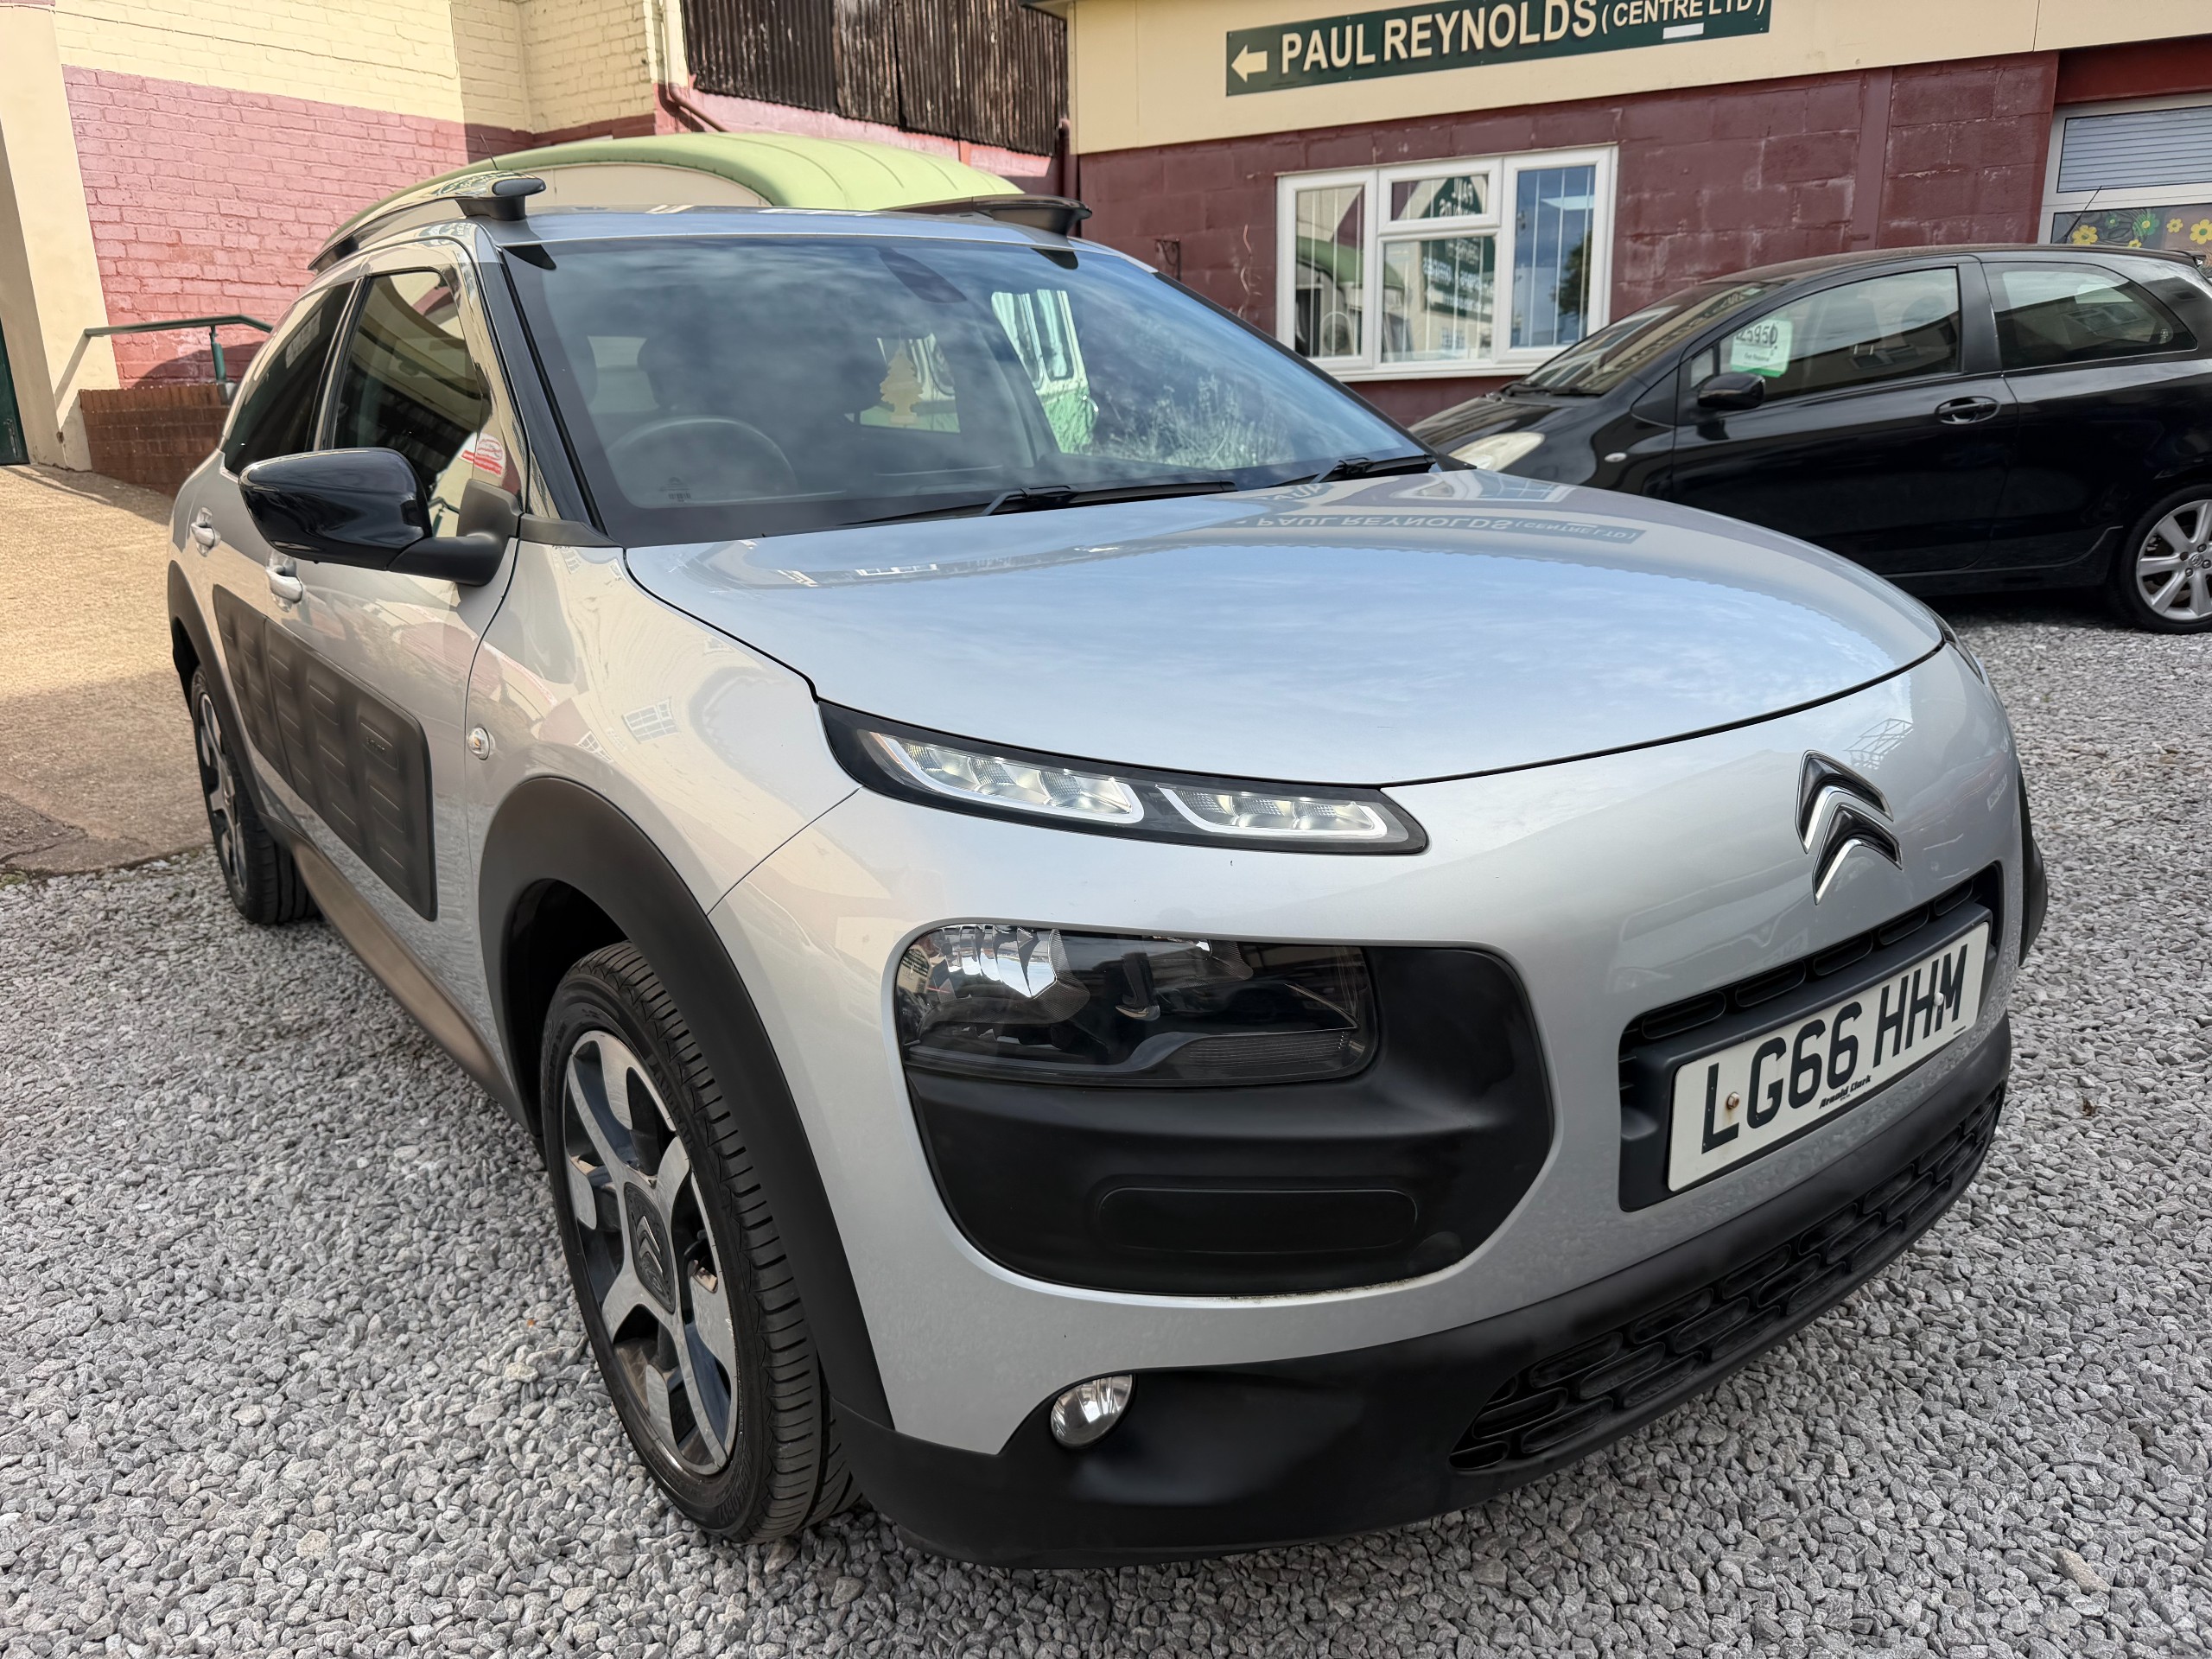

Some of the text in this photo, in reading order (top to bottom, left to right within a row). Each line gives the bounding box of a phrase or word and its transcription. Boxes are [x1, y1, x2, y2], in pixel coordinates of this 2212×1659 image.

[1281, 25, 1376, 74] PAUL
[1383, 0, 1597, 60] REYNOLDS
[1601, 0, 1703, 34] (CENTRE
[1701, 944, 1968, 1154] LG66 HHM
[1819, 1074, 1872, 1109] Arnold Clark
